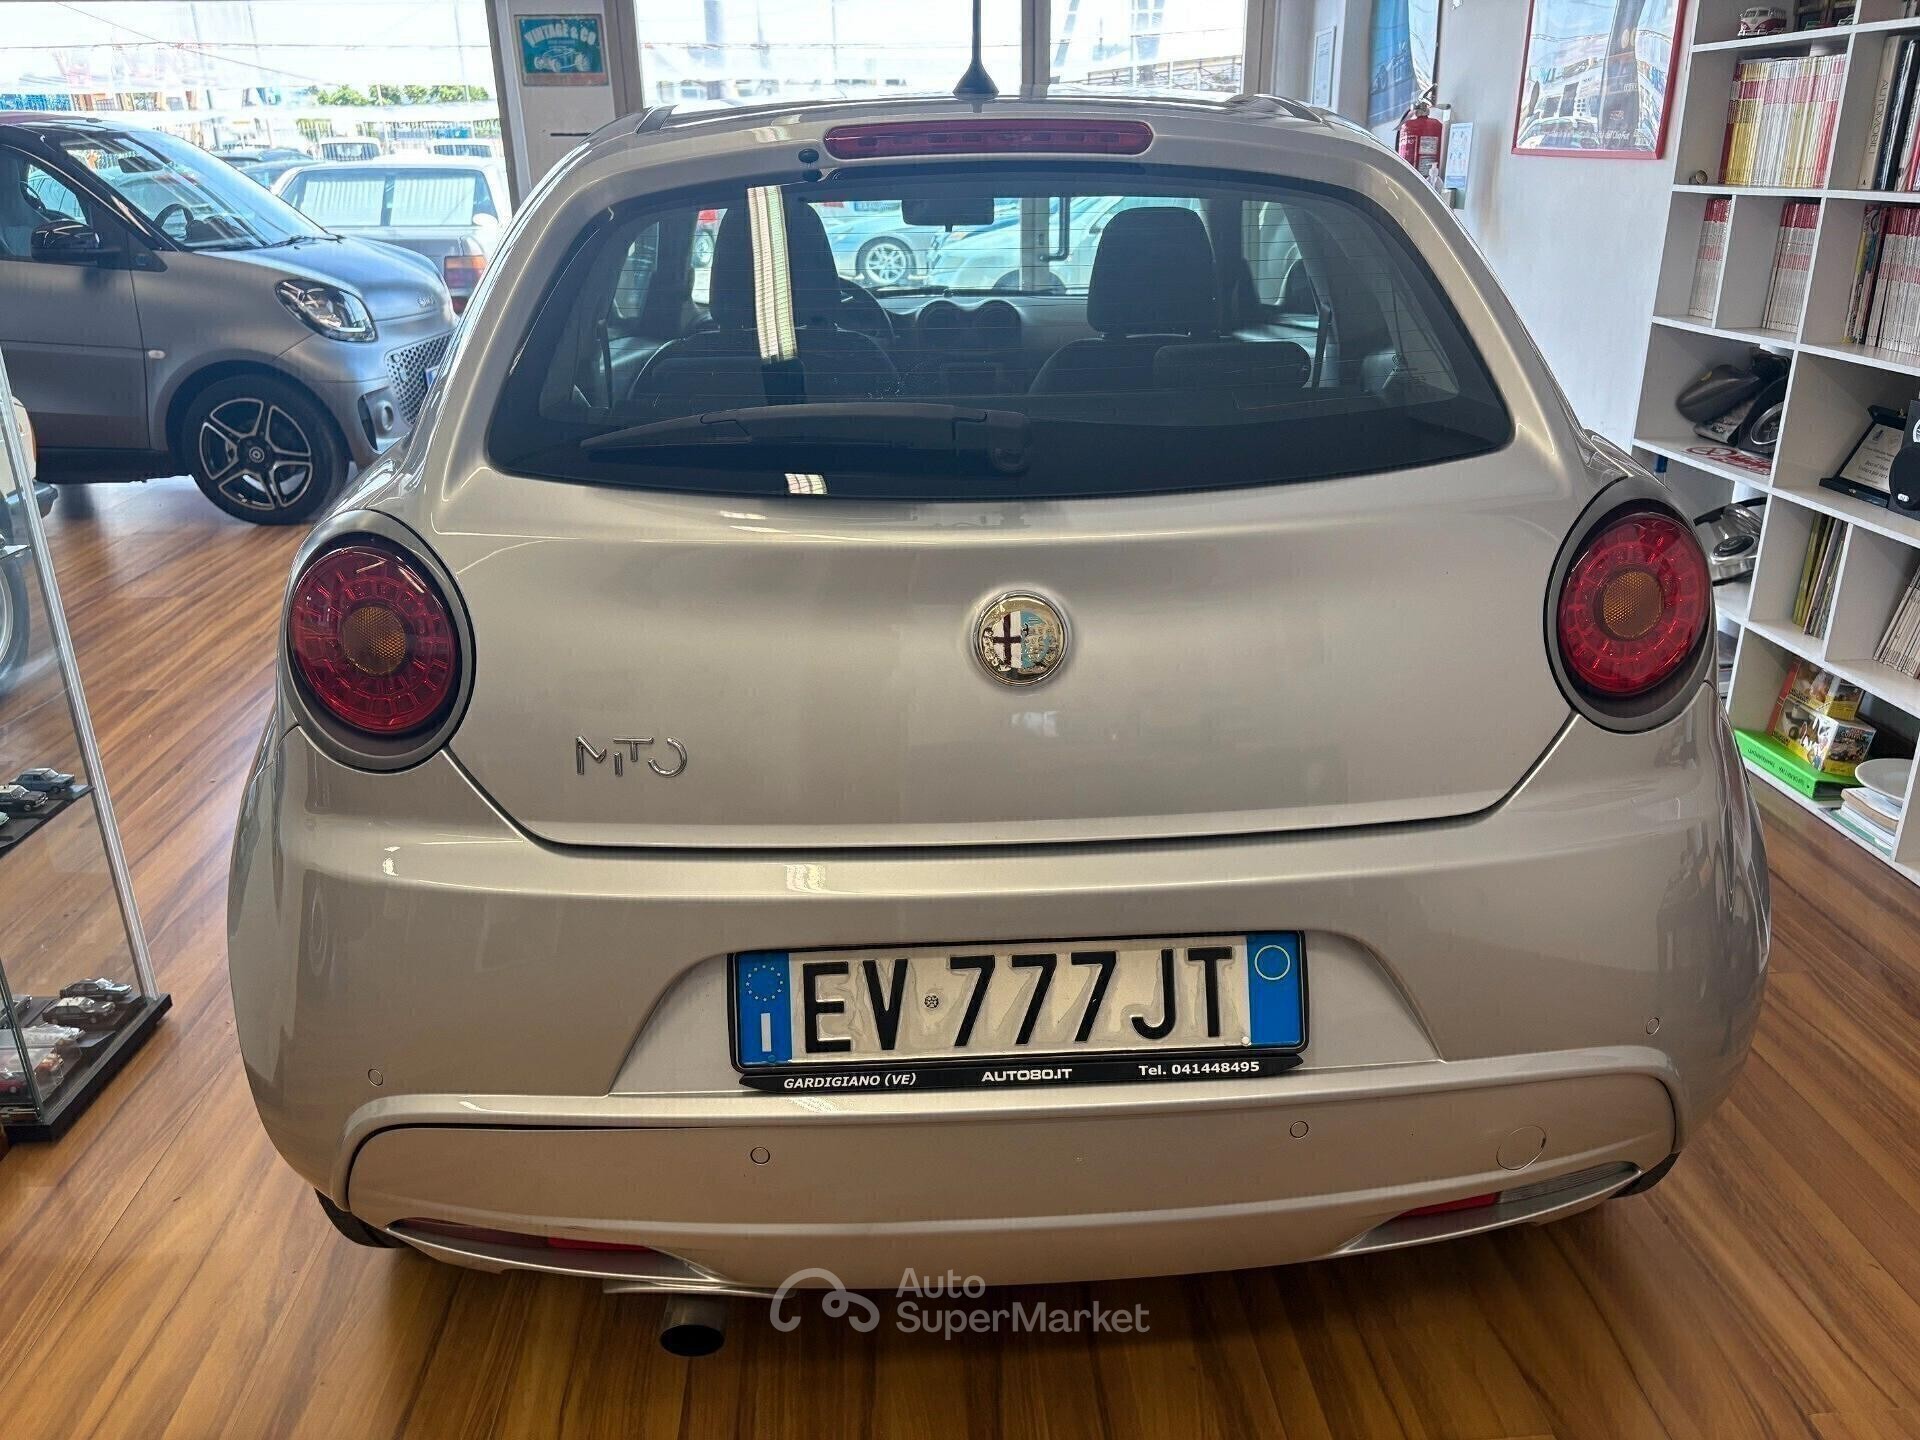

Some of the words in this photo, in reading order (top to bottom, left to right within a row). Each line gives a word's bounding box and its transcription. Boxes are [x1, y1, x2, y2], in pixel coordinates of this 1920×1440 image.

[524, 23, 569, 48] VINTAGE
[1869, 79, 1889, 154] AUTOMOBILI
[803, 958, 908, 1053] EV
[783, 1075, 881, 1089] GARDIGIANO
[884, 1072, 917, 1087] (VE)
[1139, 1063, 1167, 1077] Tel.
[1171, 1061, 1260, 1075] 041448495
